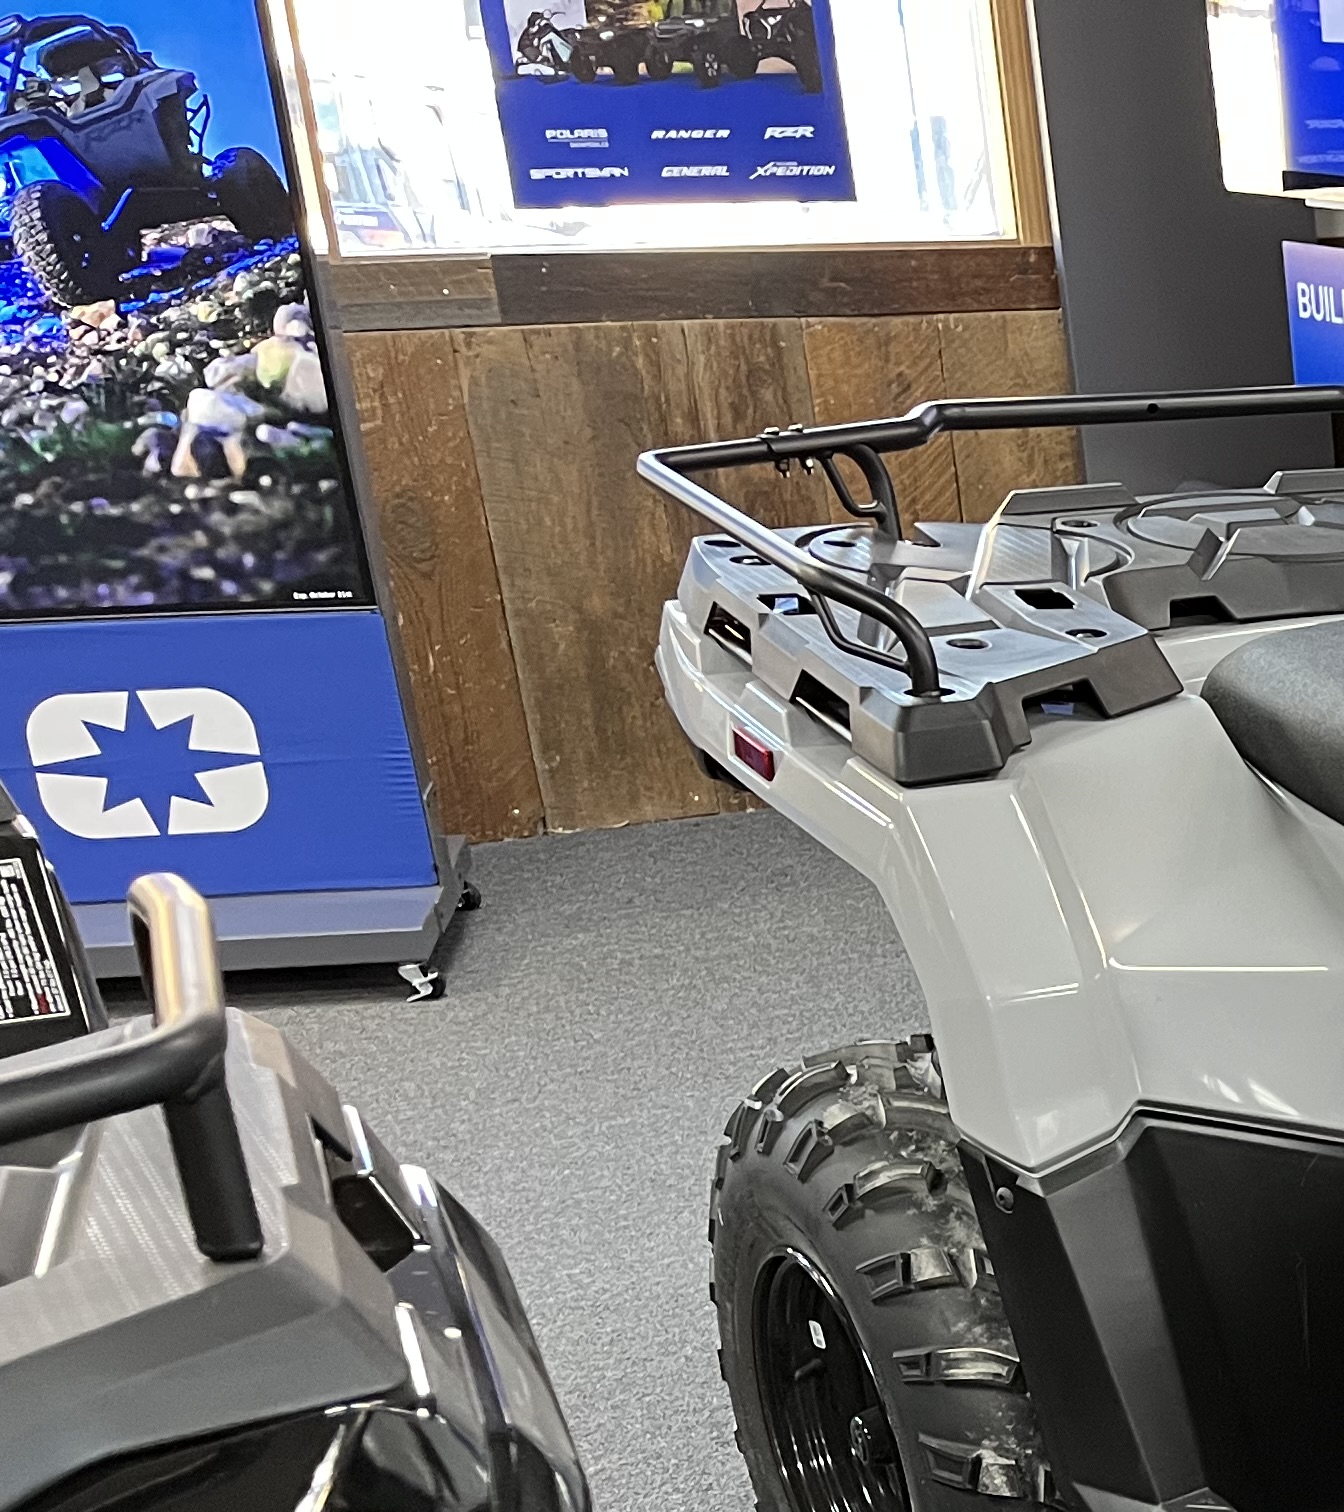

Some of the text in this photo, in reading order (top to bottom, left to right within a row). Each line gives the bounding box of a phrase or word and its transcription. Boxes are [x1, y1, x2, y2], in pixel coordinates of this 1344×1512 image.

[651, 129, 731, 139] RANGER
[764, 126, 814, 139] RZR
[530, 166, 628, 180] SPORTSMAN
[660, 164, 730, 177] GENERAL
[749, 163, 835, 179] XPEDITION
